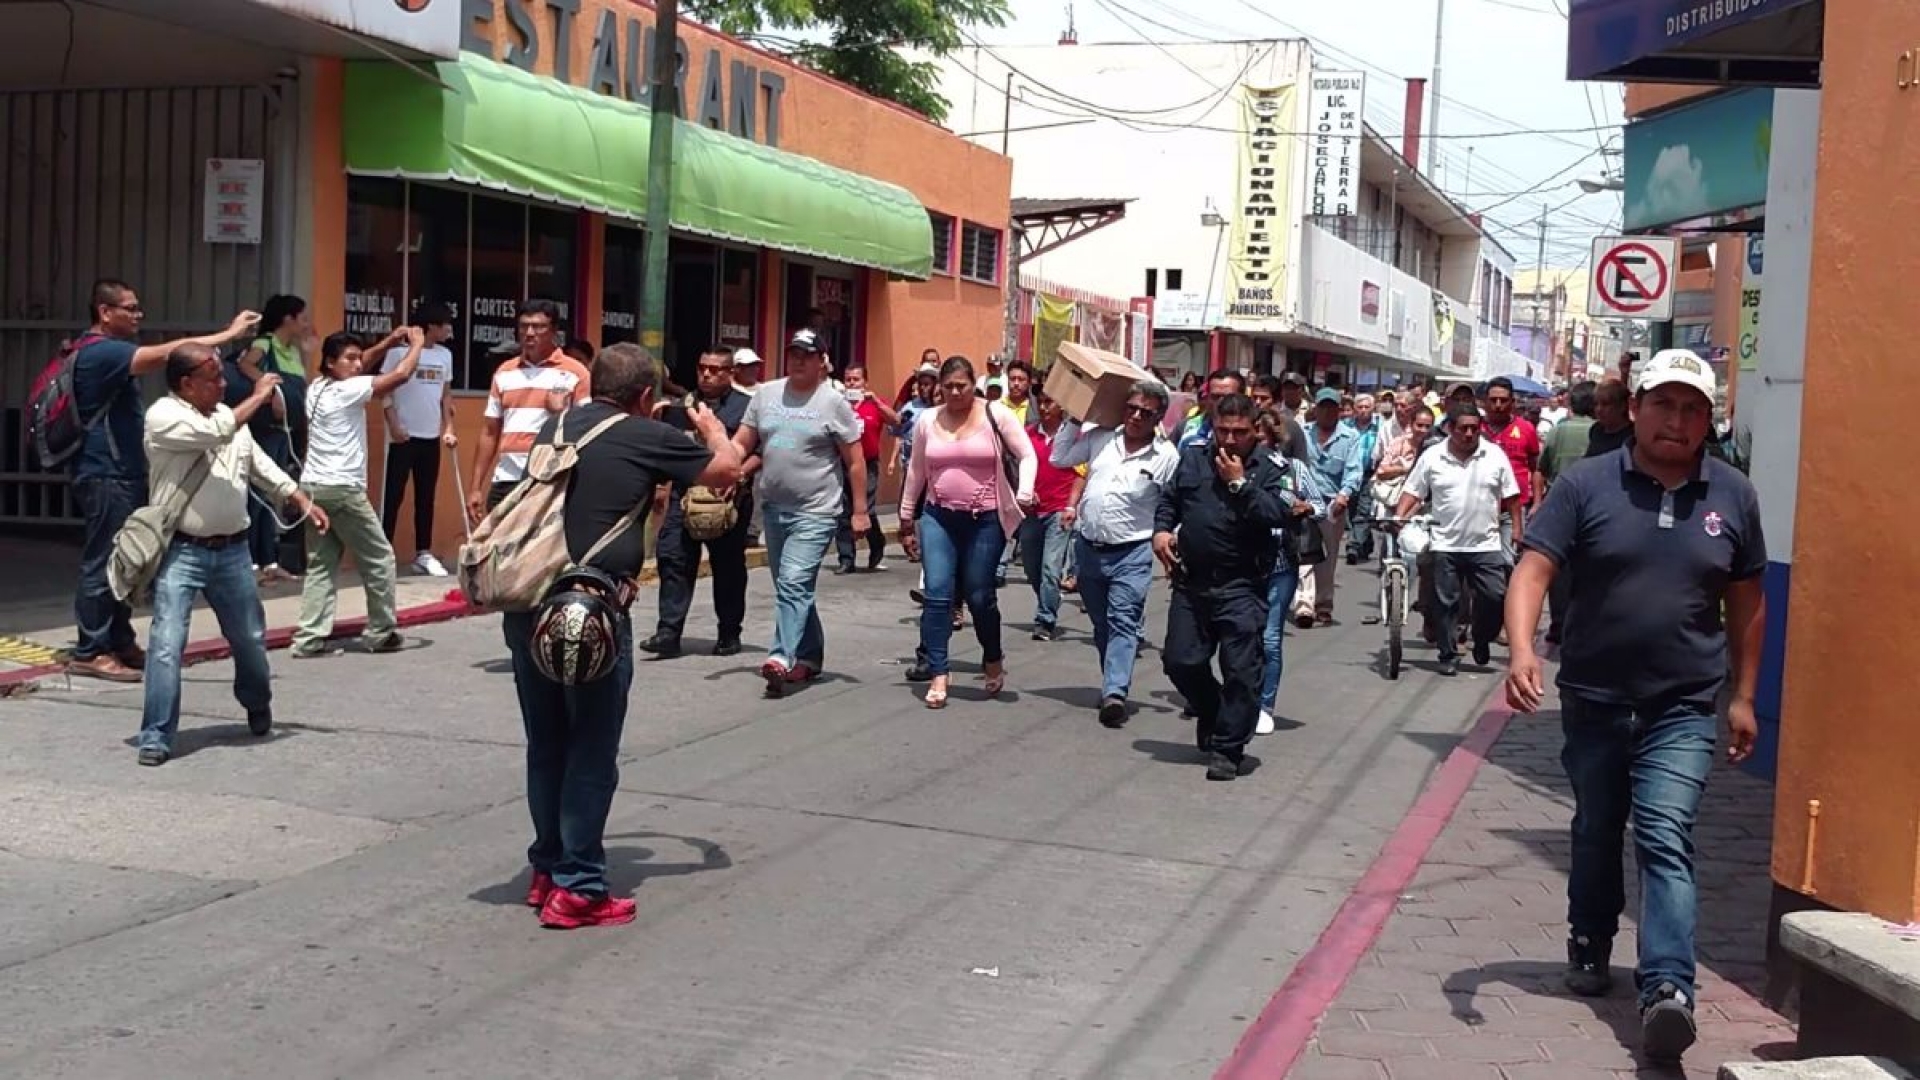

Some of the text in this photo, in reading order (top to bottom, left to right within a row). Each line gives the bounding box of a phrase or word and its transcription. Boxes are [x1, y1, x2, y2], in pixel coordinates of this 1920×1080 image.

[1666, 0, 1767, 36] DISTRIBUID
[1340, 111, 1355, 120] DE
[1340, 121, 1353, 130] LA
[1245, 90, 1278, 281] ESTACIONAMIENTO
[1615, 256, 1647, 299] E
[1238, 286, 1273, 301] BAÑOS
[474, 297, 516, 318] CORTES
